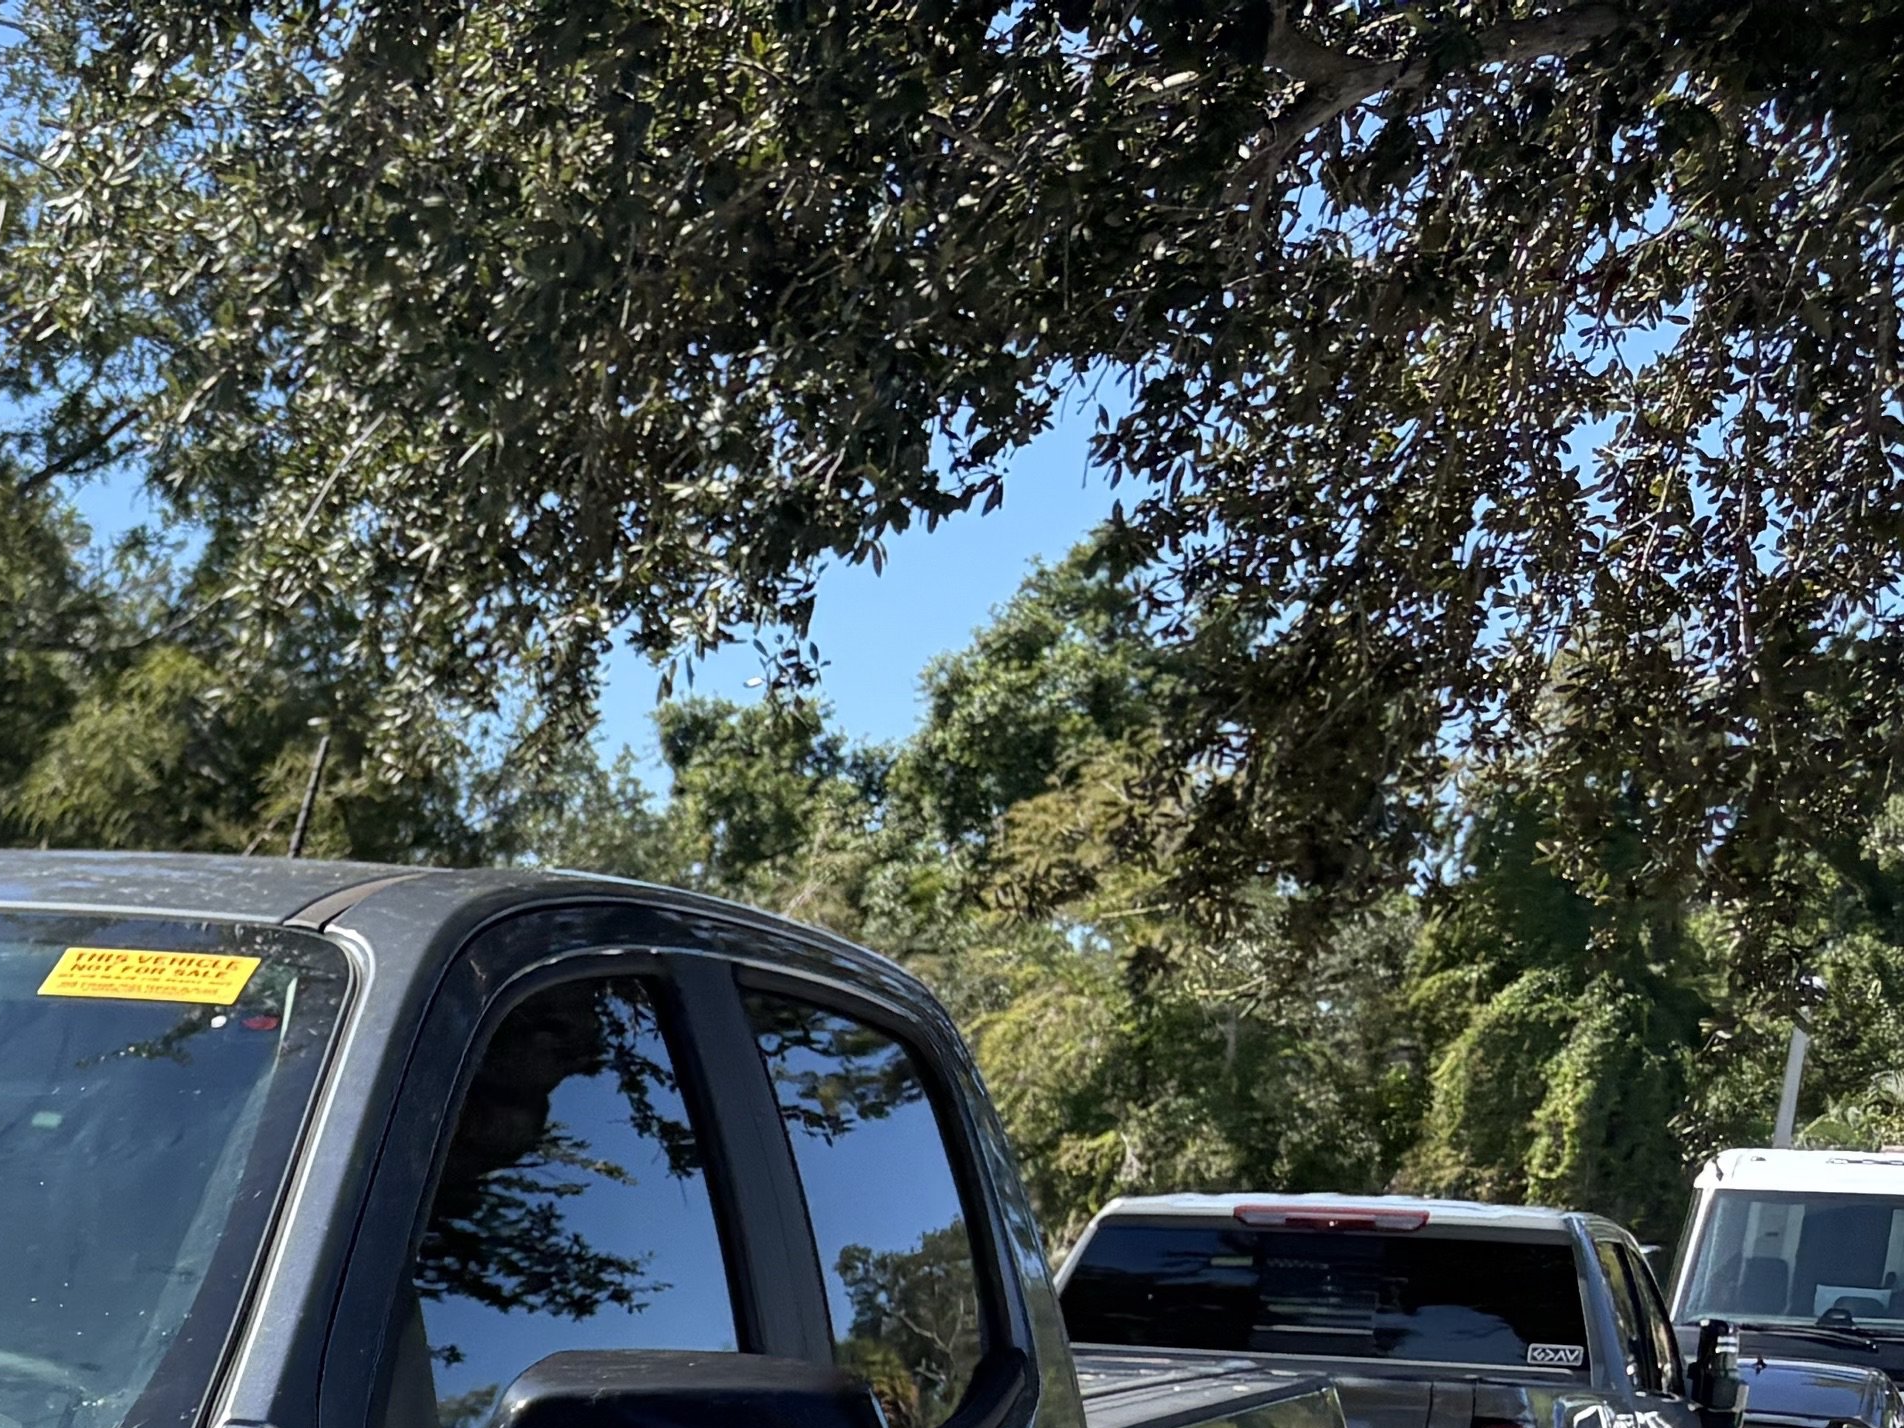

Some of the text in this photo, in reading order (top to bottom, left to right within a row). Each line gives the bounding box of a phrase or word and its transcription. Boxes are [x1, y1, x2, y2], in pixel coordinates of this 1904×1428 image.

[74, 952, 242, 971] THIS VEHICLE
[70, 963, 229, 979] NOT FOR SALE
